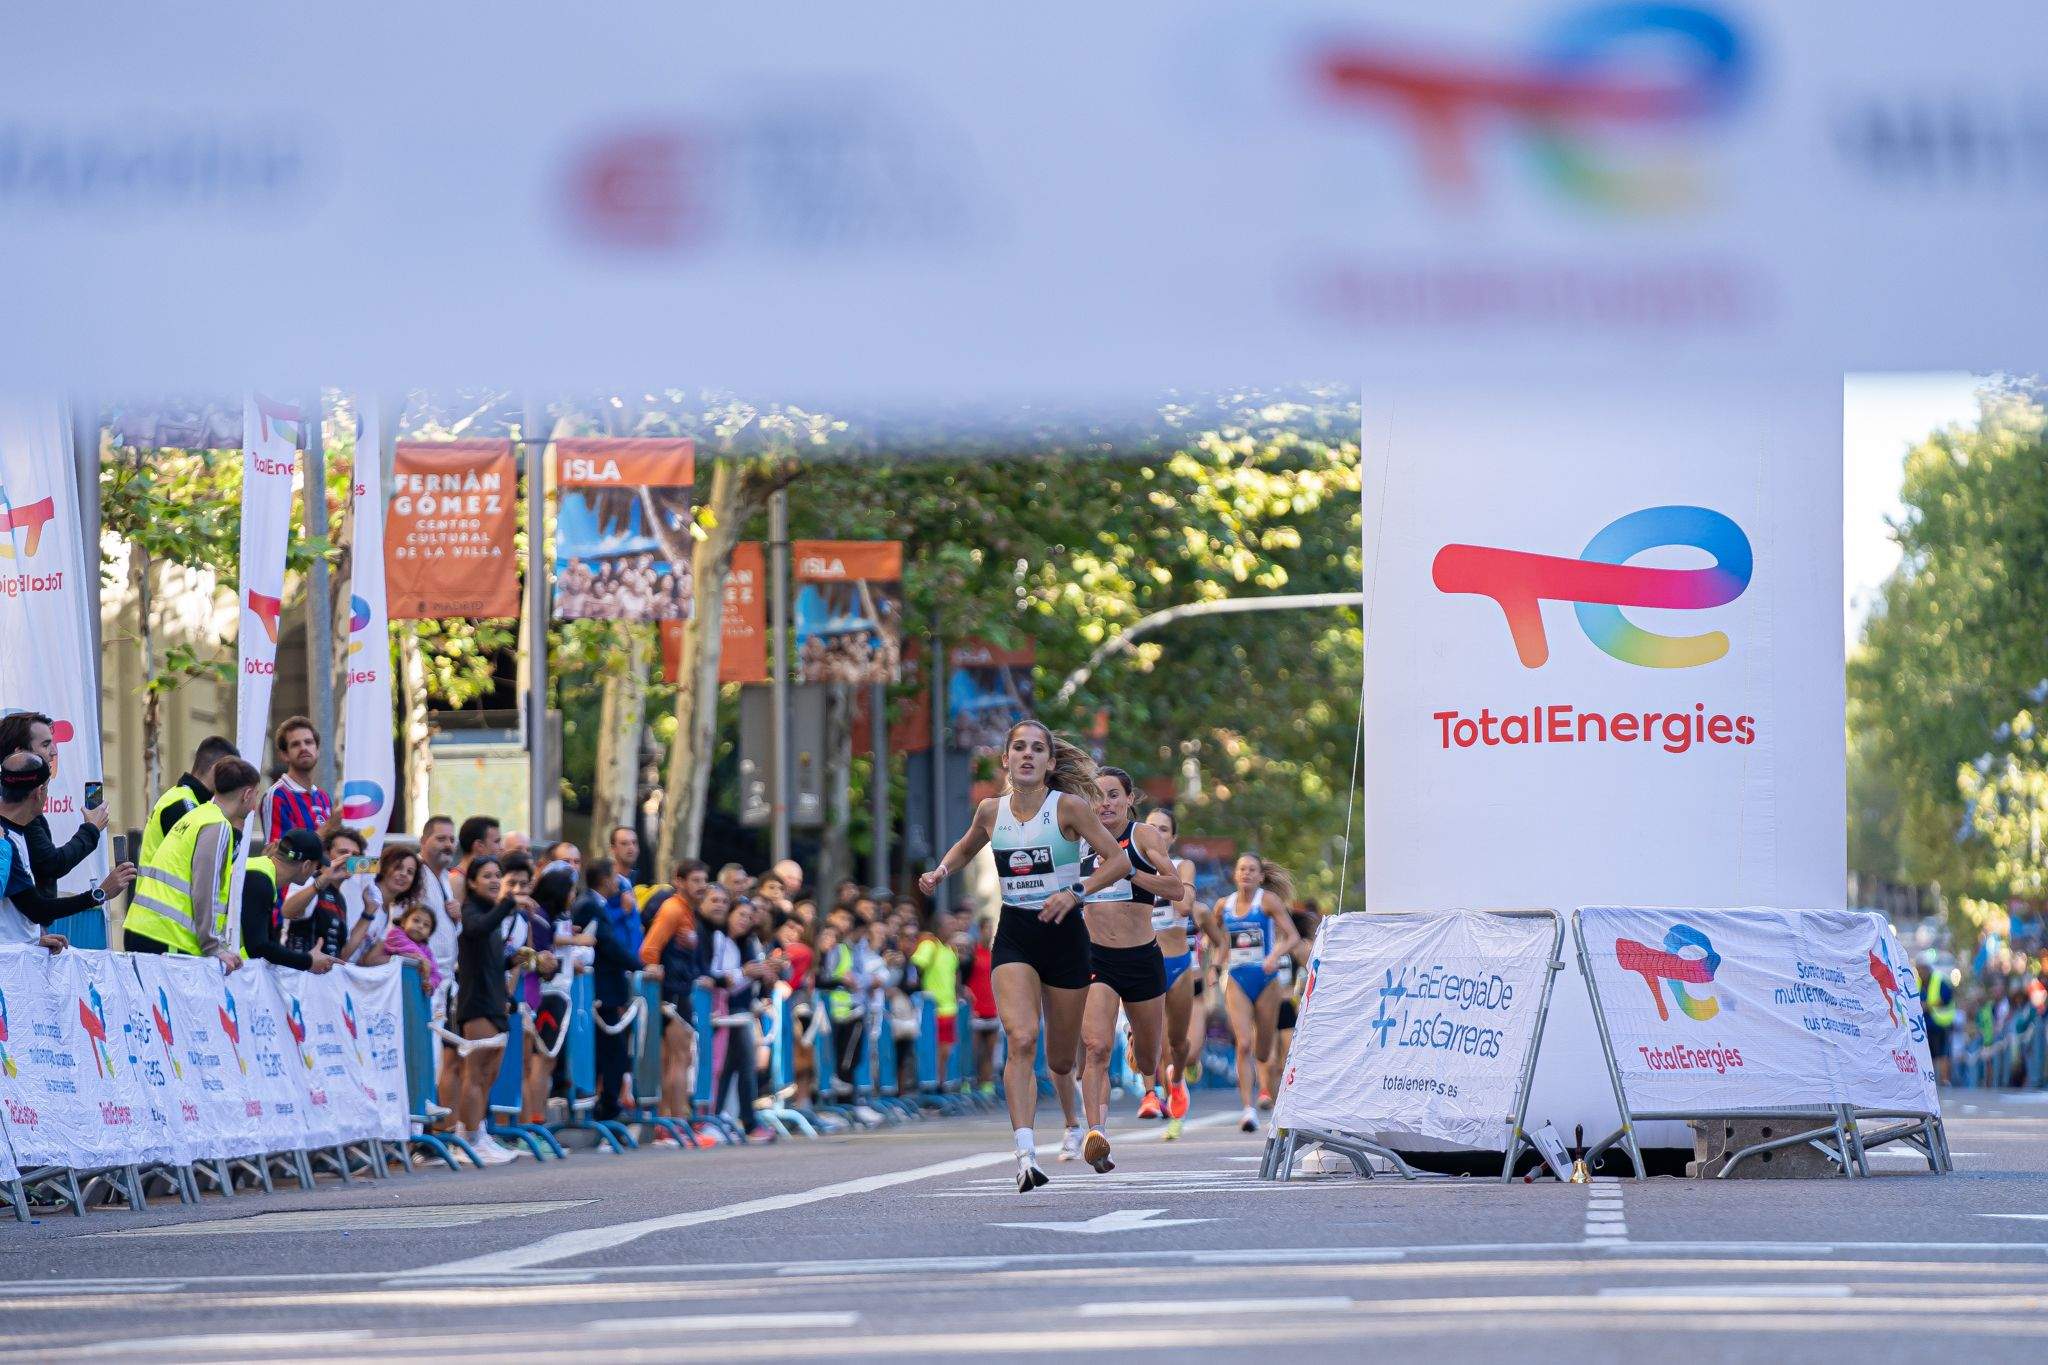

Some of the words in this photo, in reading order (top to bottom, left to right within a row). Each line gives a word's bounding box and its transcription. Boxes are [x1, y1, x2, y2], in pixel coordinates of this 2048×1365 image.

[563, 459, 621, 481] ISLA
[394, 469, 501, 492] FERNÁN
[394, 491, 502, 515] GÓMEZ
[415, 519, 480, 530] CENTRO
[406, 532, 490, 544] CULTURAL
[395, 547, 416, 559] DE
[424, 547, 445, 557] LA
[452, 546, 501, 558] VILLA
[1433, 702, 1756, 755] TotalEnergies
[1032, 848, 1050, 863] 25
[1007, 882, 1016, 890] M.
[1016, 880, 1045, 890] GARZZIA
[1638, 1041, 1744, 1075] TotalEnergies
